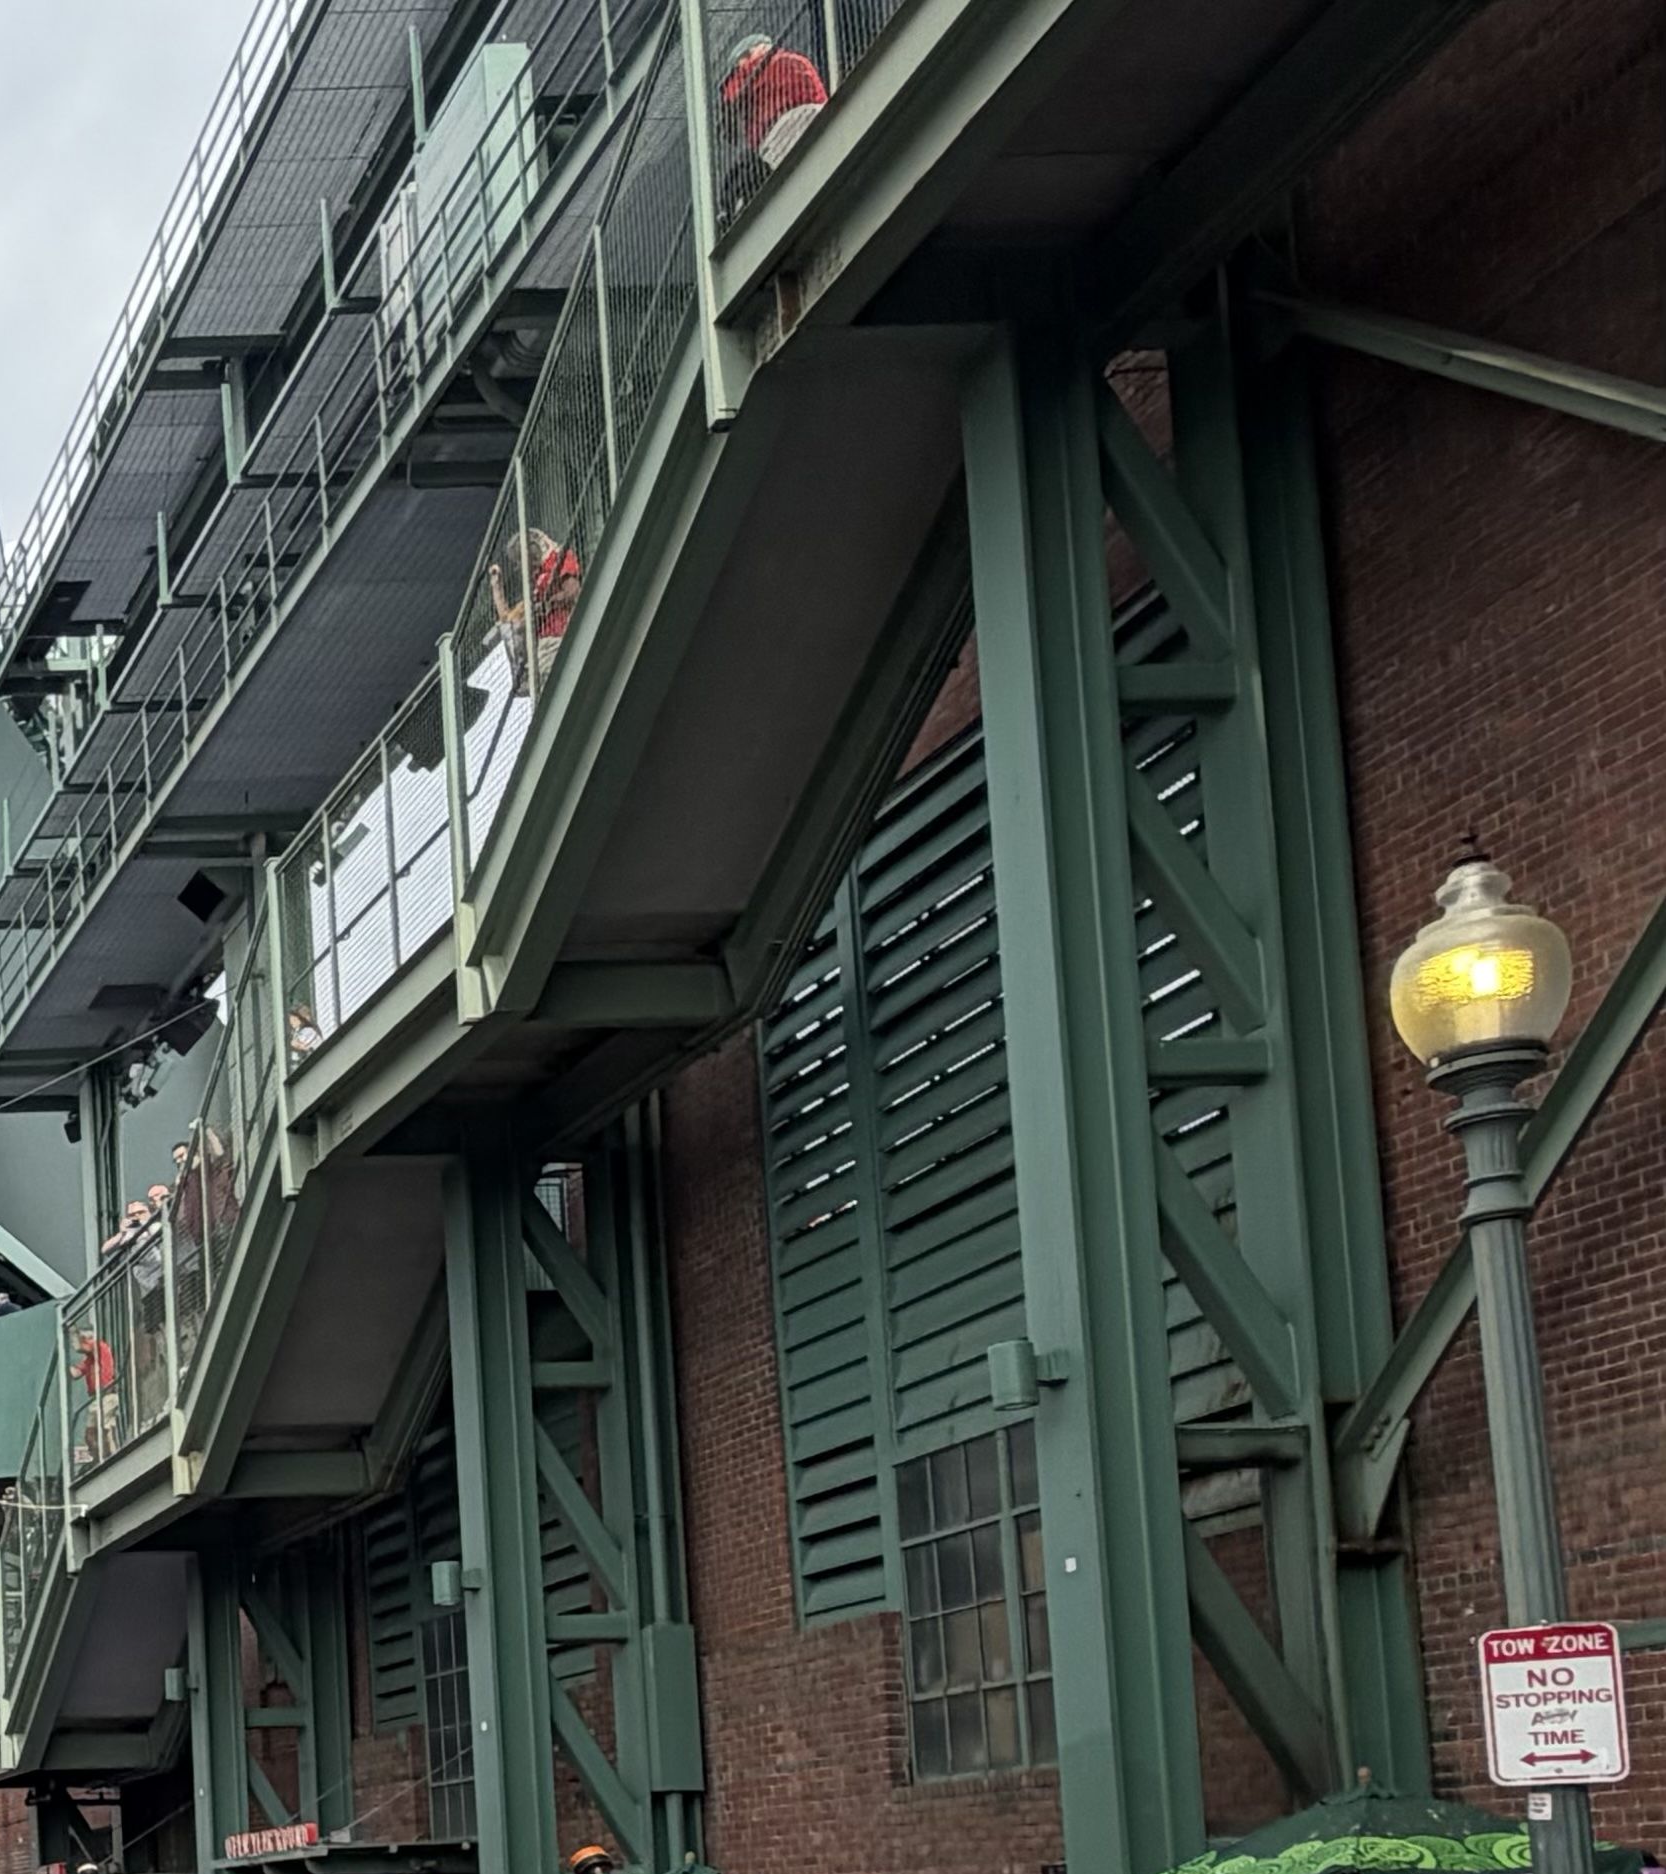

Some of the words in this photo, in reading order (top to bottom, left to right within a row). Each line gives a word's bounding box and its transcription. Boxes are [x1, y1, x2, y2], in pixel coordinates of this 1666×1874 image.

[1488, 1638, 1535, 1658] TOW
[1546, 1632, 1611, 1654] ZONE
[1526, 1667, 1575, 1688] NO
[1496, 1687, 1613, 1710] STOPPING
[1528, 1729, 1586, 1746] TIME
